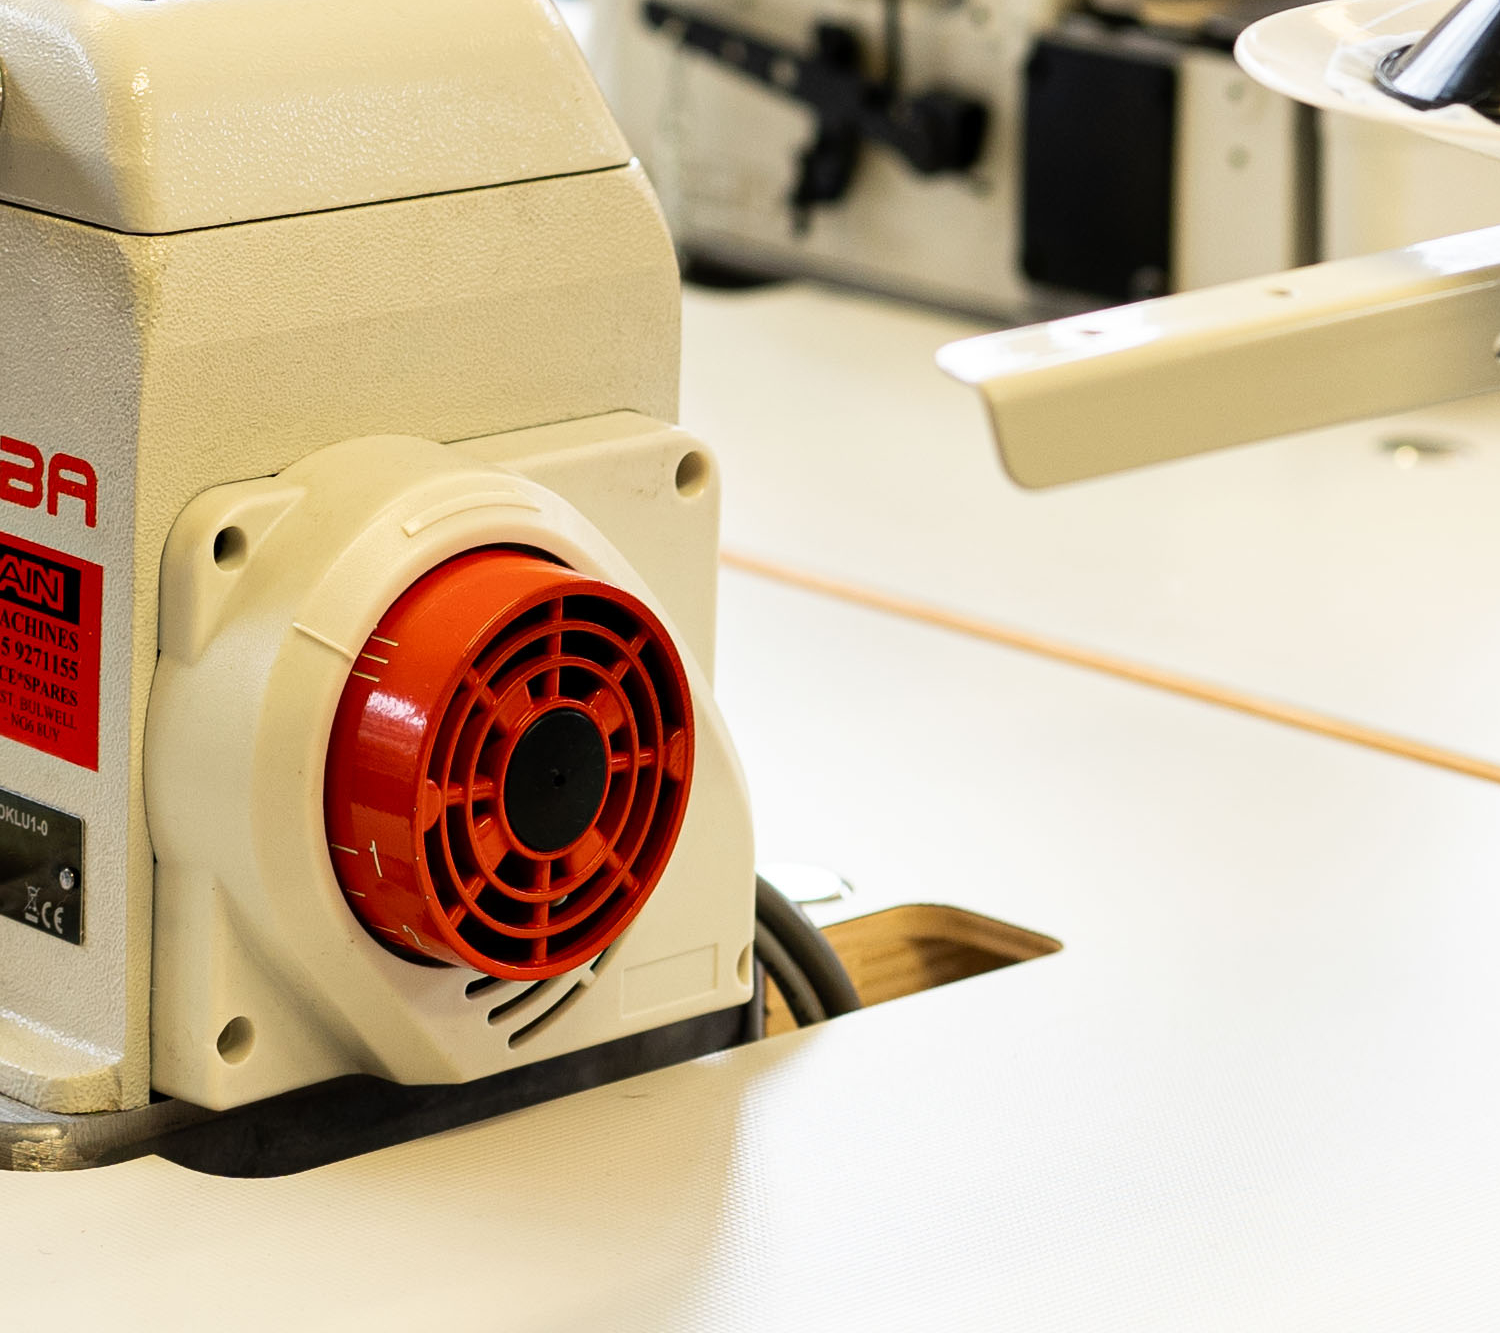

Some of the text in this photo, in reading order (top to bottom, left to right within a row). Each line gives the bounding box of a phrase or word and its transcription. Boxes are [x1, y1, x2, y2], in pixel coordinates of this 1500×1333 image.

[15, 640, 78, 681] 9271155
[20, 697, 77, 730] BULWELL
[369, 839, 382, 878] 1
